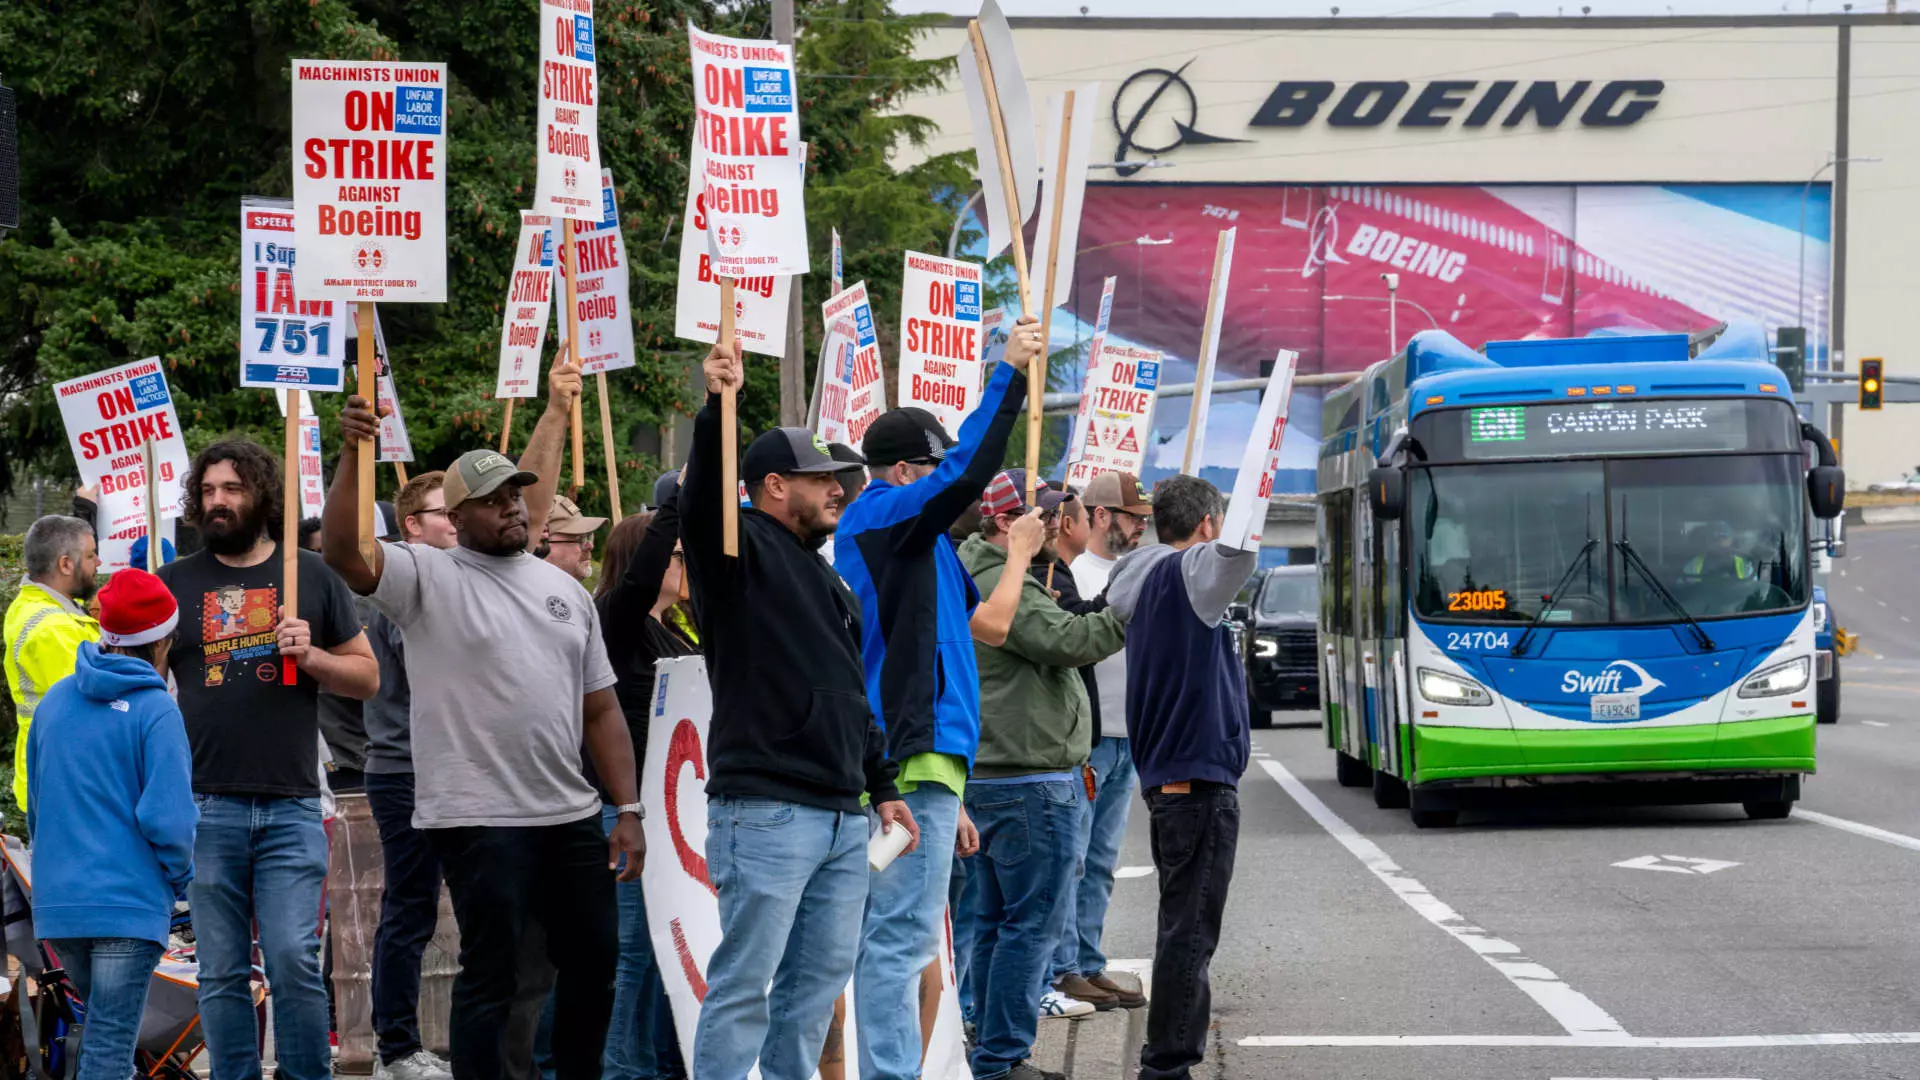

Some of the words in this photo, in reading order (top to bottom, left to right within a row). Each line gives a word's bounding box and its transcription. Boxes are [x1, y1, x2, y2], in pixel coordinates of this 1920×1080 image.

[556, 16, 575, 58] ON
[299, 66, 390, 82] MACHINISTS
[394, 69, 440, 82] UNION
[544, 60, 594, 106] STRIKE
[704, 64, 744, 108] ON
[752, 70, 782, 81] UNFAIR
[754, 82, 782, 92] LABOR
[405, 90, 434, 101] UNFAIR
[406, 102, 432, 113] LABOR
[1248, 80, 1665, 128] BOEING
[344, 90, 394, 132] ON
[396, 114, 441, 126] PRACTICES!
[555, 107, 580, 125] AGAINST
[548, 124, 590, 162] Boeing
[699, 108, 788, 156] TRIKE
[304, 138, 434, 180] STRIKE
[706, 158, 755, 181] AGAINST
[338, 186, 400, 202] AGAINST
[705, 182, 779, 218] oeing
[254, 216, 288, 228] SPEEA
[318, 204, 421, 240] Boeing
[254, 242, 261, 262] I
[266, 242, 296, 269] Sup
[528, 233, 545, 264] ON
[558, 235, 618, 278] SRIKE
[1346, 224, 1468, 284] BOEING
[908, 257, 953, 276] MACHINISTS
[954, 266, 979, 280] UNION
[353, 279, 384, 287] DISTRICT
[384, 280, 404, 288] LODGE
[406, 280, 416, 288] 751
[356, 288, 384, 296] AFL-CIO
[512, 270, 550, 302] STRIKE
[577, 277, 604, 294] AGAINST
[578, 295, 616, 322] oeing
[929, 280, 954, 318] ON
[255, 318, 330, 356] 751
[508, 322, 540, 348] Boeing
[907, 318, 976, 362] STRIKE
[60, 372, 124, 397] MACHINISTS
[124, 362, 157, 379] UNION
[852, 346, 880, 392] RIKE
[924, 360, 956, 378] AGAINST
[1112, 362, 1136, 385] ON
[97, 386, 136, 420] ON
[912, 374, 966, 412] Boeing
[1100, 387, 1148, 414] TRIKE
[1547, 411, 1637, 433] CANYON
[1645, 408, 1708, 430] PARK
[78, 411, 174, 460] STRIKE
[111, 453, 143, 470] AGAIN
[1072, 464, 1088, 480] AT
[100, 462, 174, 495] Boeig
[1258, 471, 1272, 498] Bo
[1448, 590, 1506, 612] 23005
[204, 639, 238, 656] WAFFLE
[1447, 632, 1509, 650] 24704
[1561, 670, 1622, 694] Swift
